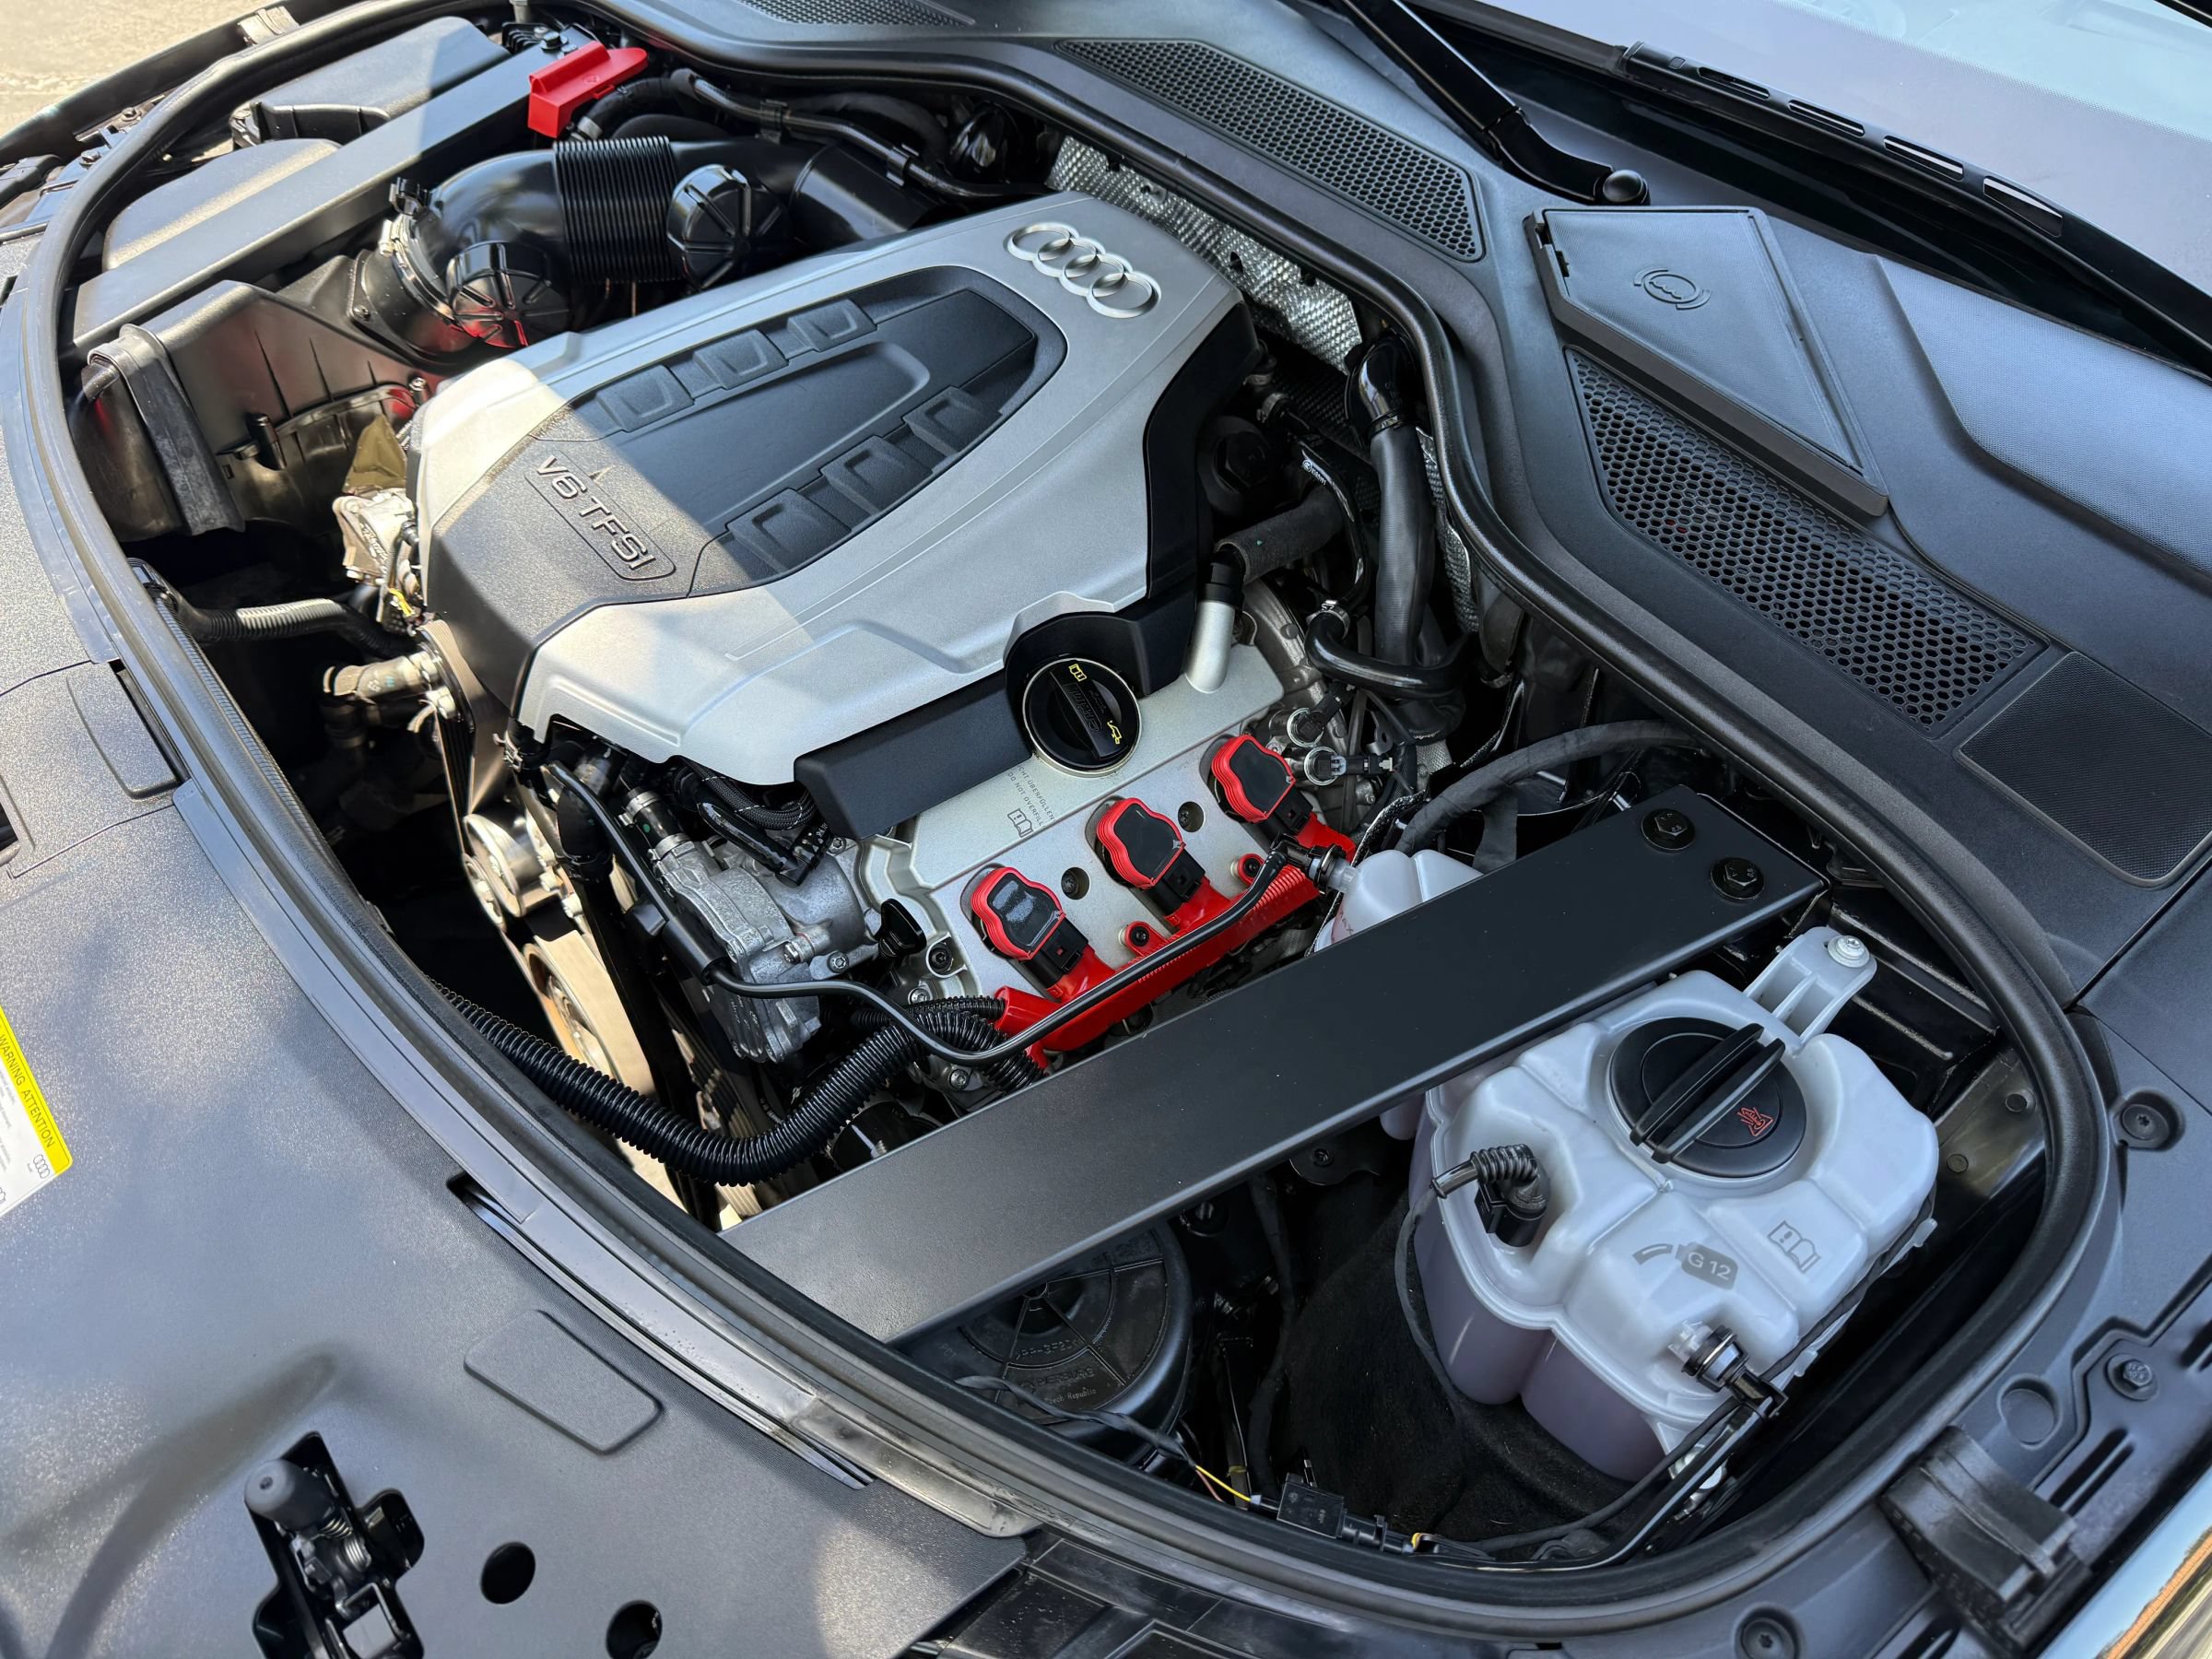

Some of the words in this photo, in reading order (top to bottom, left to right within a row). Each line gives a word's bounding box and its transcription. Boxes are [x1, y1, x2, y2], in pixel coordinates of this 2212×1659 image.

[537, 455, 588, 500] V6
[579, 496, 656, 571] TFSI
[1007, 772, 1017, 782] DO
[1015, 782, 1026, 795] NOT
[1023, 796, 1044, 827] OVERFILL
[0, 1034, 26, 1086] WARNING
[22, 1088, 55, 1148] ATTENTION
[1688, 1251, 1704, 1268] G
[1710, 1260, 1731, 1280] 12
